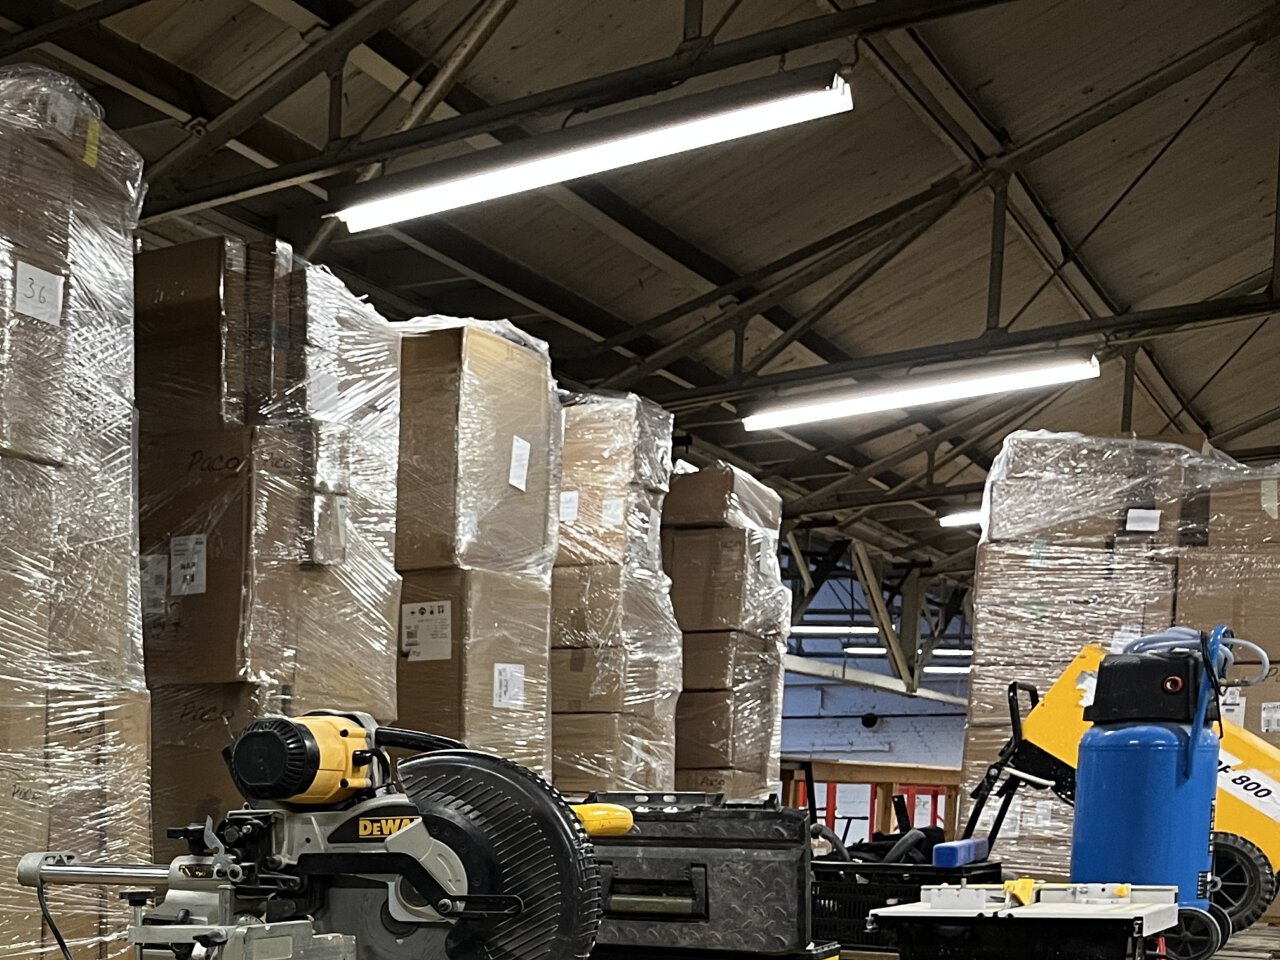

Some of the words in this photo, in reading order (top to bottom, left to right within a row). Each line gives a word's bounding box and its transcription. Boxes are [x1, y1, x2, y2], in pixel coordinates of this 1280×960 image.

[24, 277, 47, 304] 36
[189, 451, 240, 472] Paco
[1231, 775, 1272, 798] 800
[359, 818, 412, 836] DEWA
